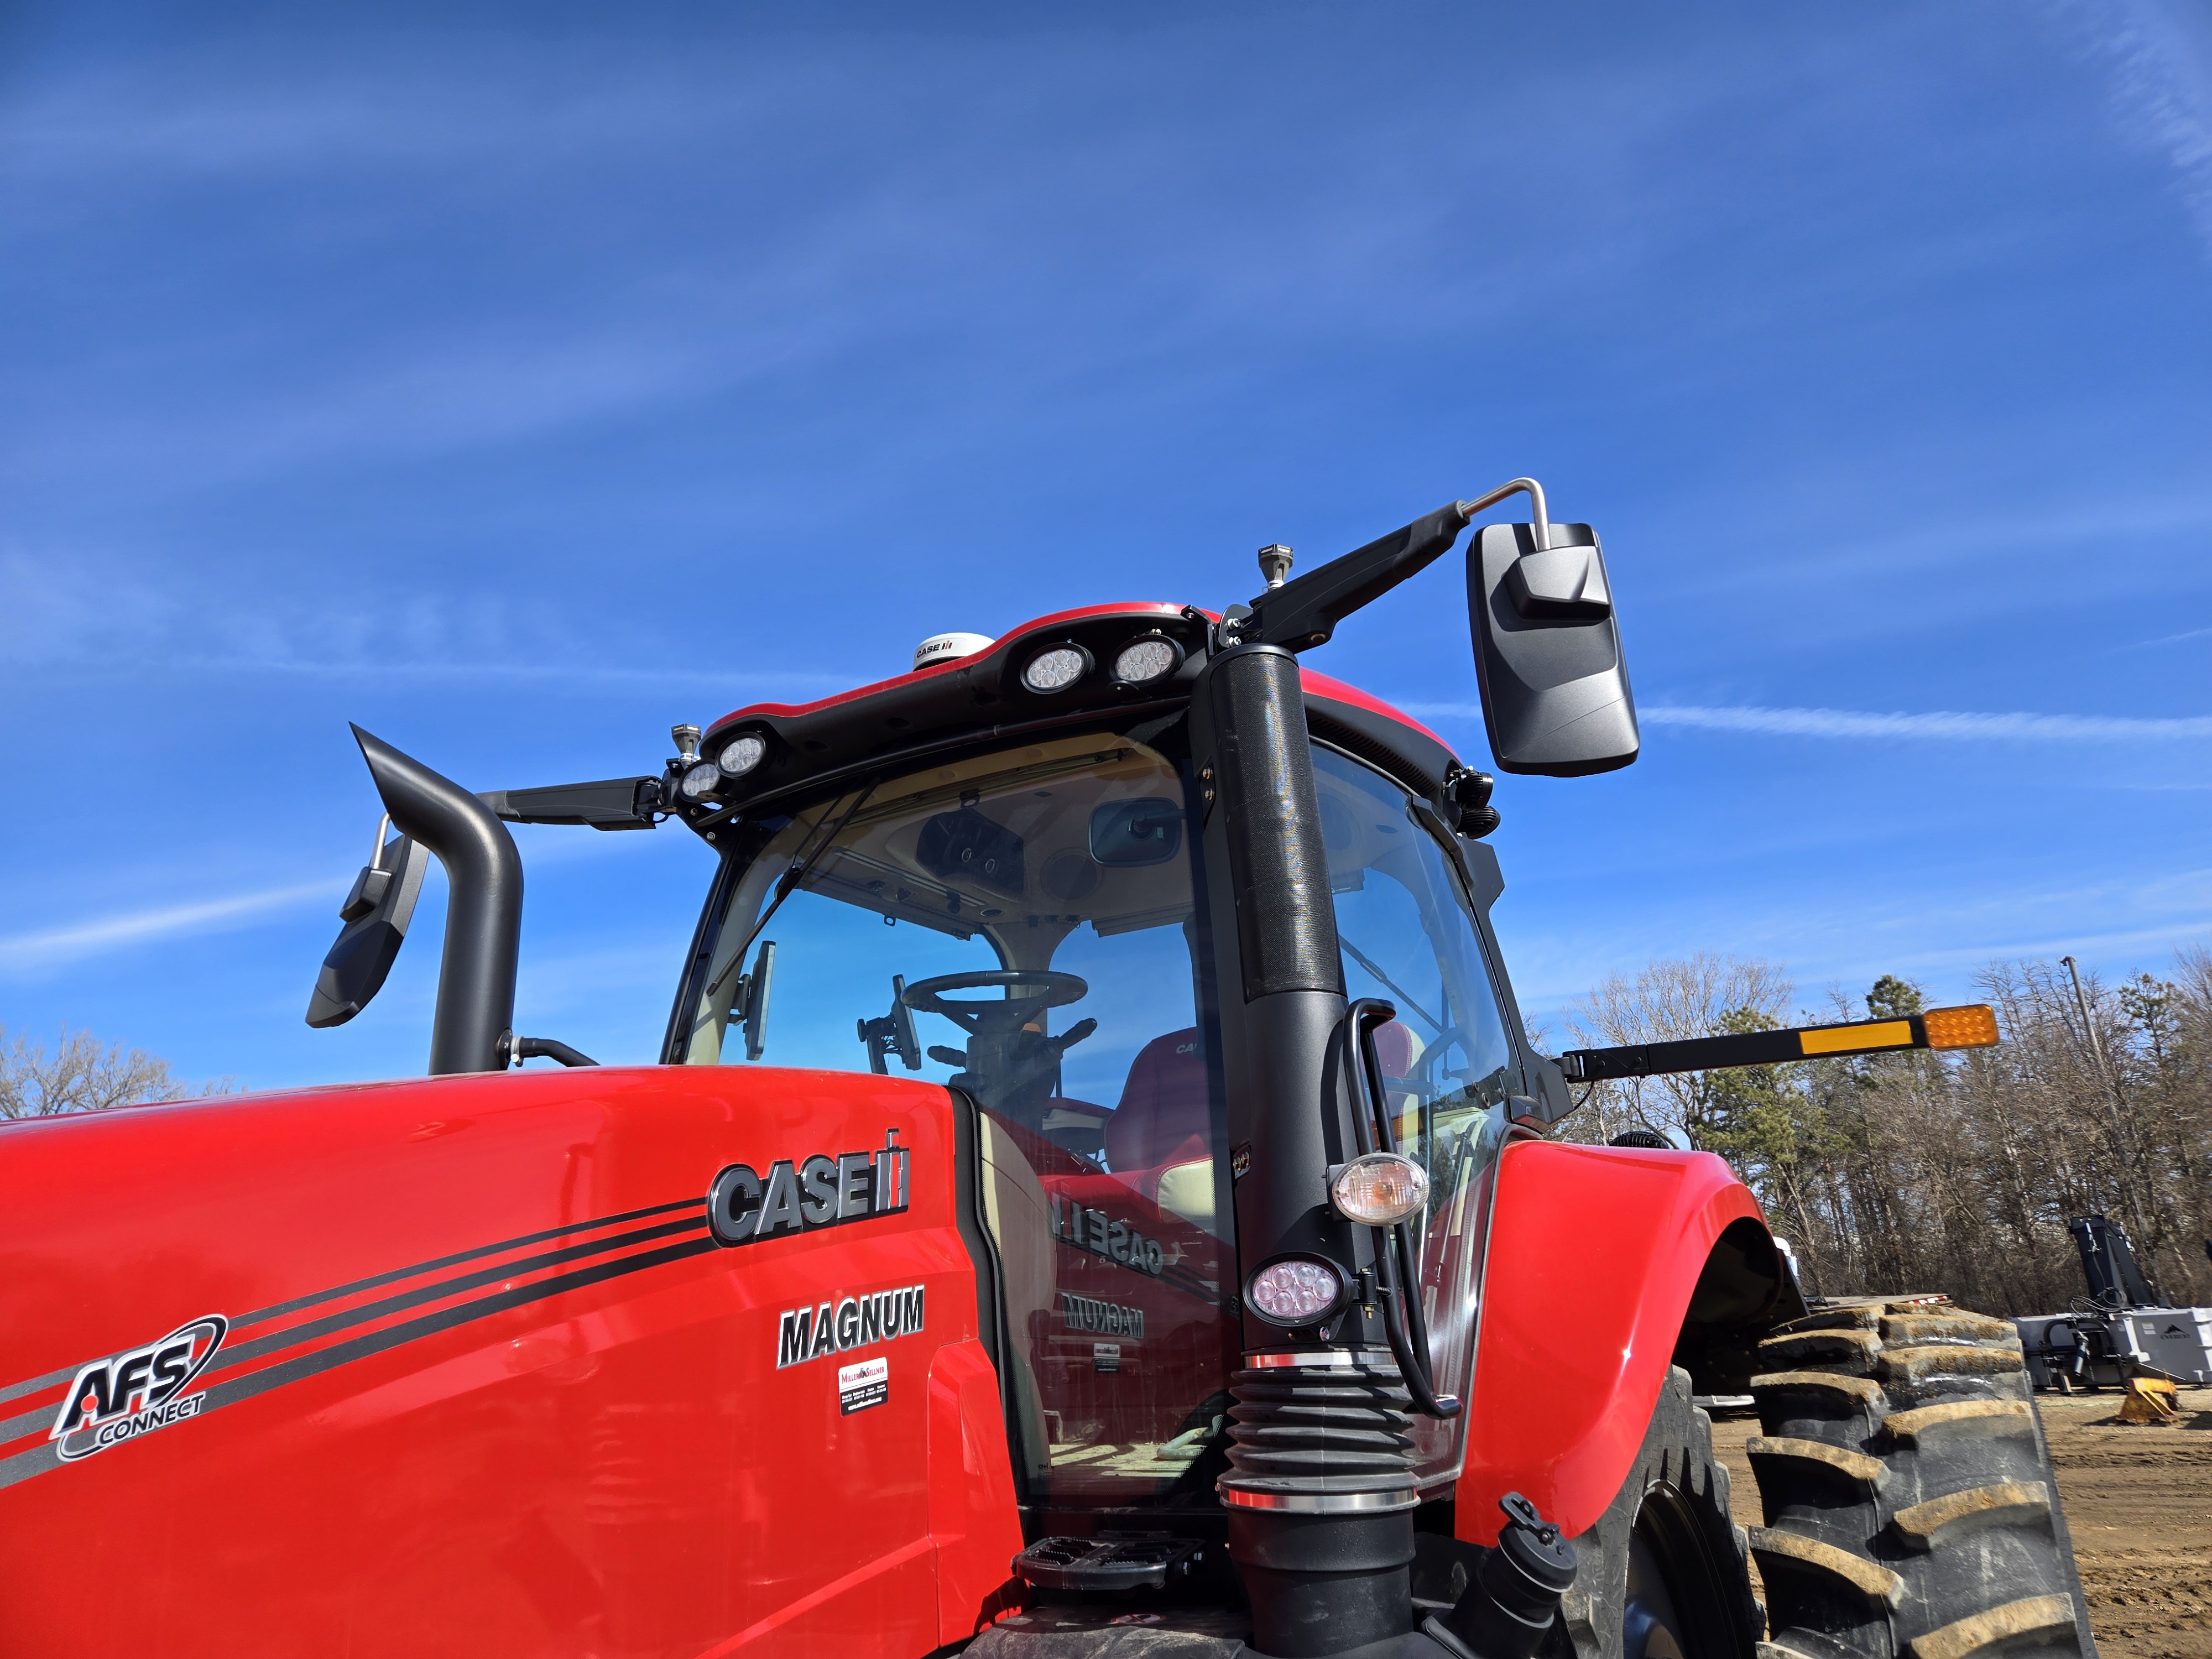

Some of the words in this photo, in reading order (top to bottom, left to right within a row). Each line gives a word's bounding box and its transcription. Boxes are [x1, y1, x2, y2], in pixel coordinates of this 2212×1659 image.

[916, 644, 941, 658] CASE
[776, 1285, 925, 1370] MAGNUM
[49, 1334, 195, 1439] AFS
[866, 1366, 885, 1377] SELLNER
[97, 1392, 206, 1445] CONNECT
